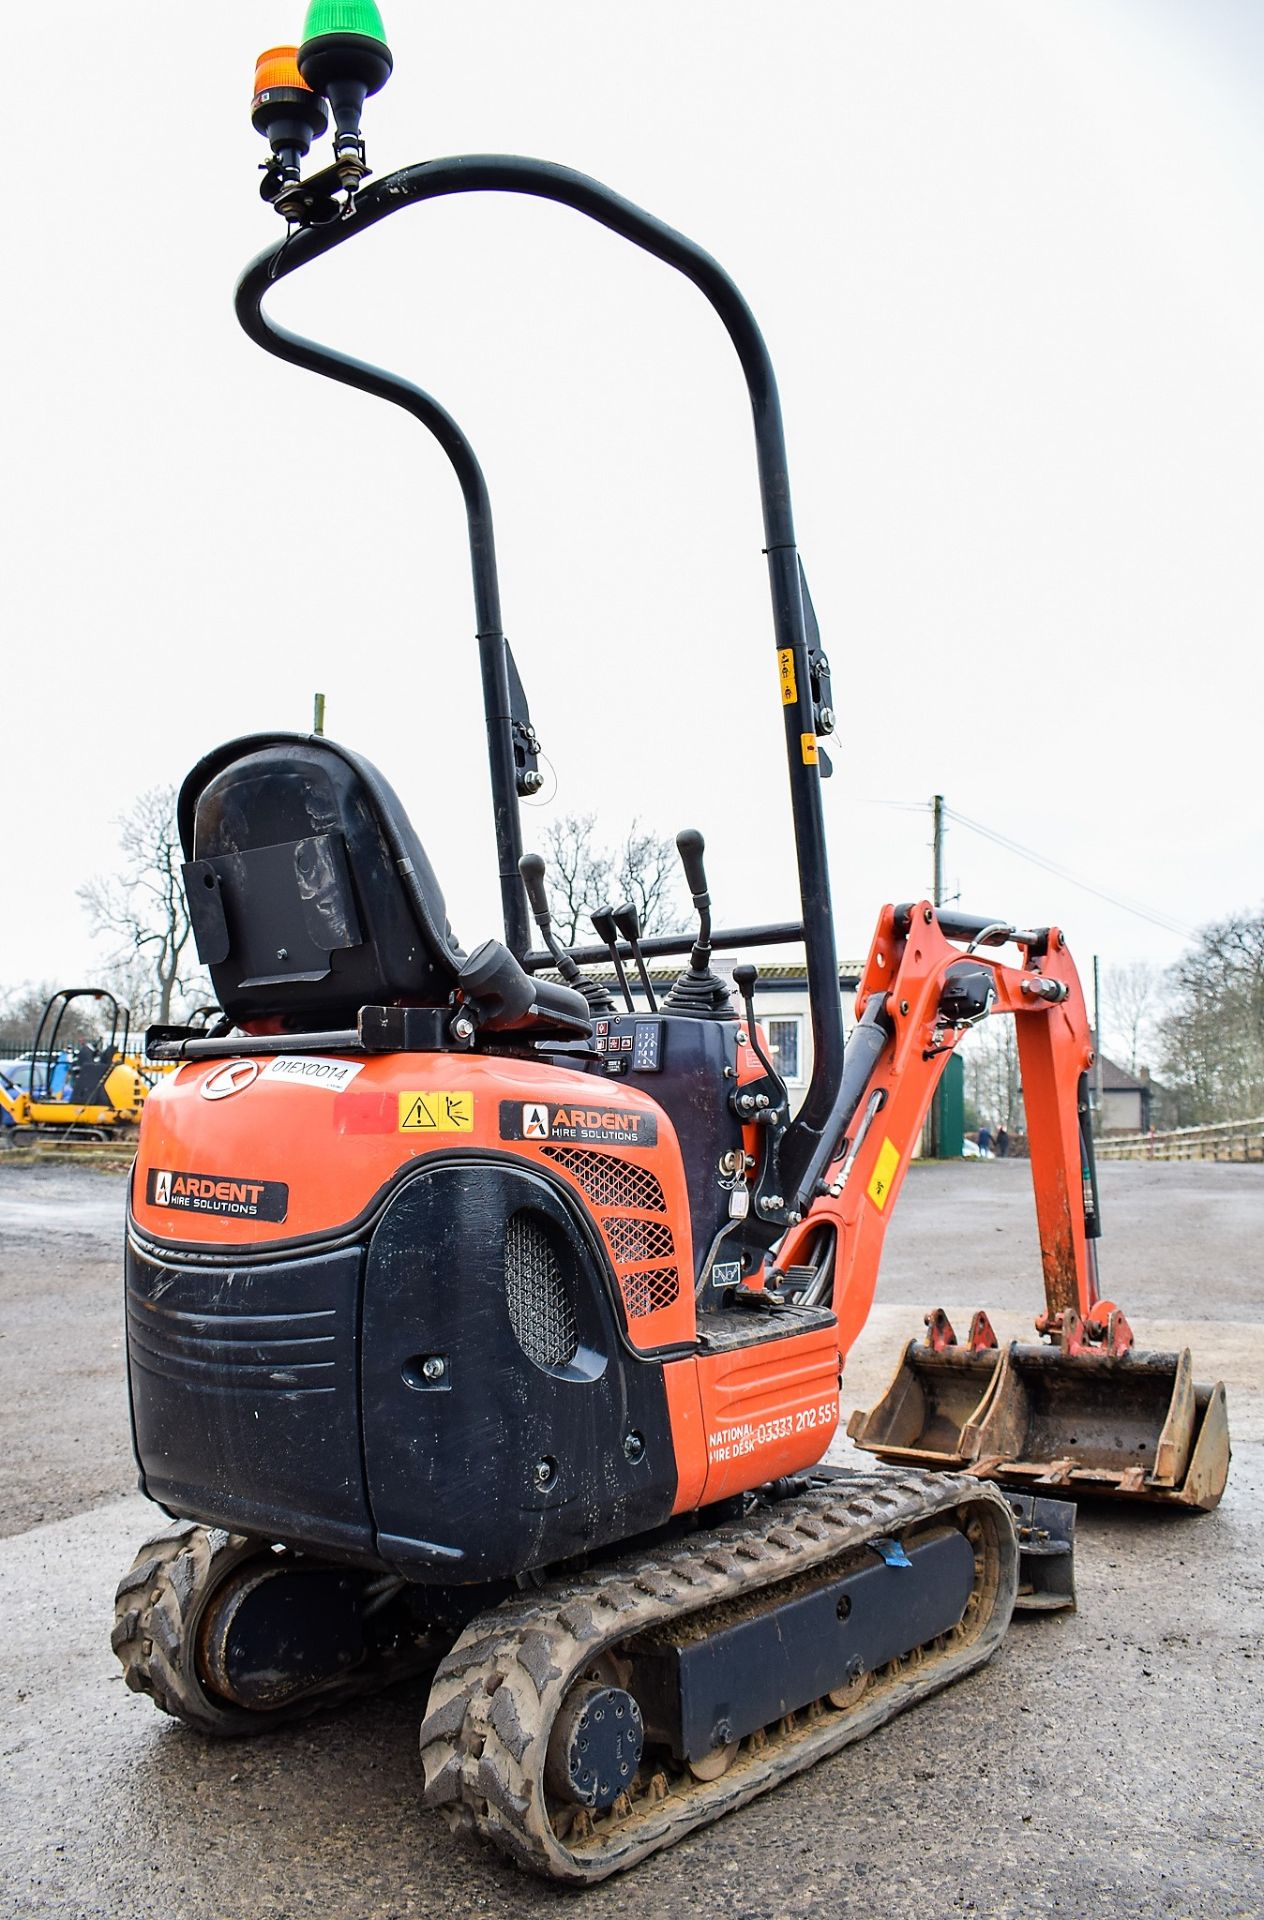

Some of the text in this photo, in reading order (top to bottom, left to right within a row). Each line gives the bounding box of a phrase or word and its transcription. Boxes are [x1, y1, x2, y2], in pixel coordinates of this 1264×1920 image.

[272, 1060, 348, 1080] 01EX0014
[552, 1109, 641, 1132] ARDENT
[552, 1128, 638, 1142] HIRE SOLUTIONS
[172, 1176, 264, 1204] ARDENT
[171, 1196, 258, 1215] HIRE SOLUTIONS
[709, 1424, 754, 1447] NATIONAL
[757, 1415, 792, 1444] 03333
[732, 1439, 754, 1458] DESK
